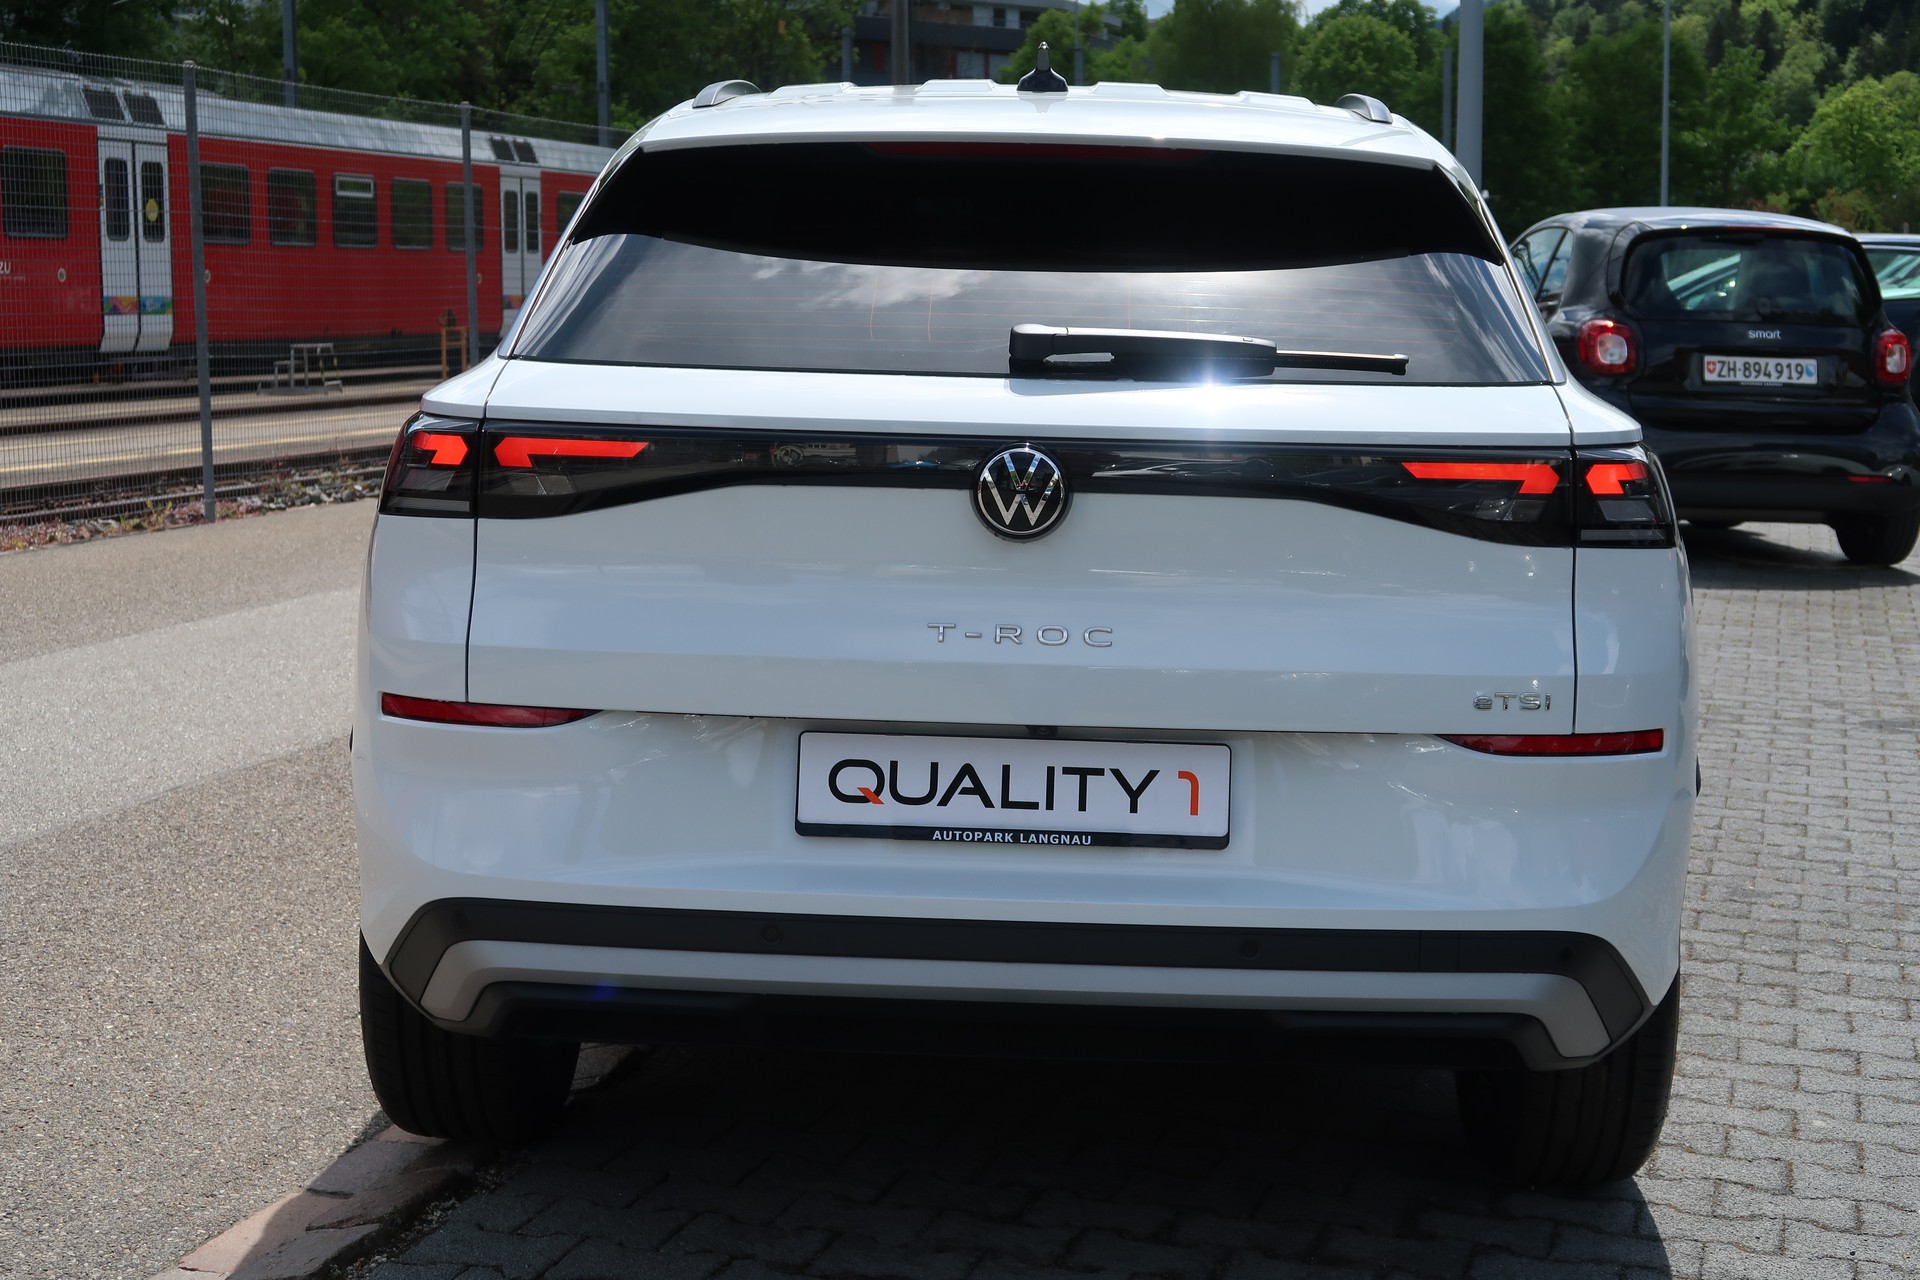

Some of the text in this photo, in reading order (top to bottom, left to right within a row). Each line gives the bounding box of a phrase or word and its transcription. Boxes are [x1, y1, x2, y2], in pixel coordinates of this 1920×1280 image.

[1748, 329, 1782, 339] smart
[979, 448, 1064, 536] VW
[927, 622, 1113, 648] T-ROC
[1473, 691, 1552, 711] eTSI
[828, 759, 1199, 816] QUALITY 1
[932, 830, 1092, 846] AUTOPARK LANGNAU
